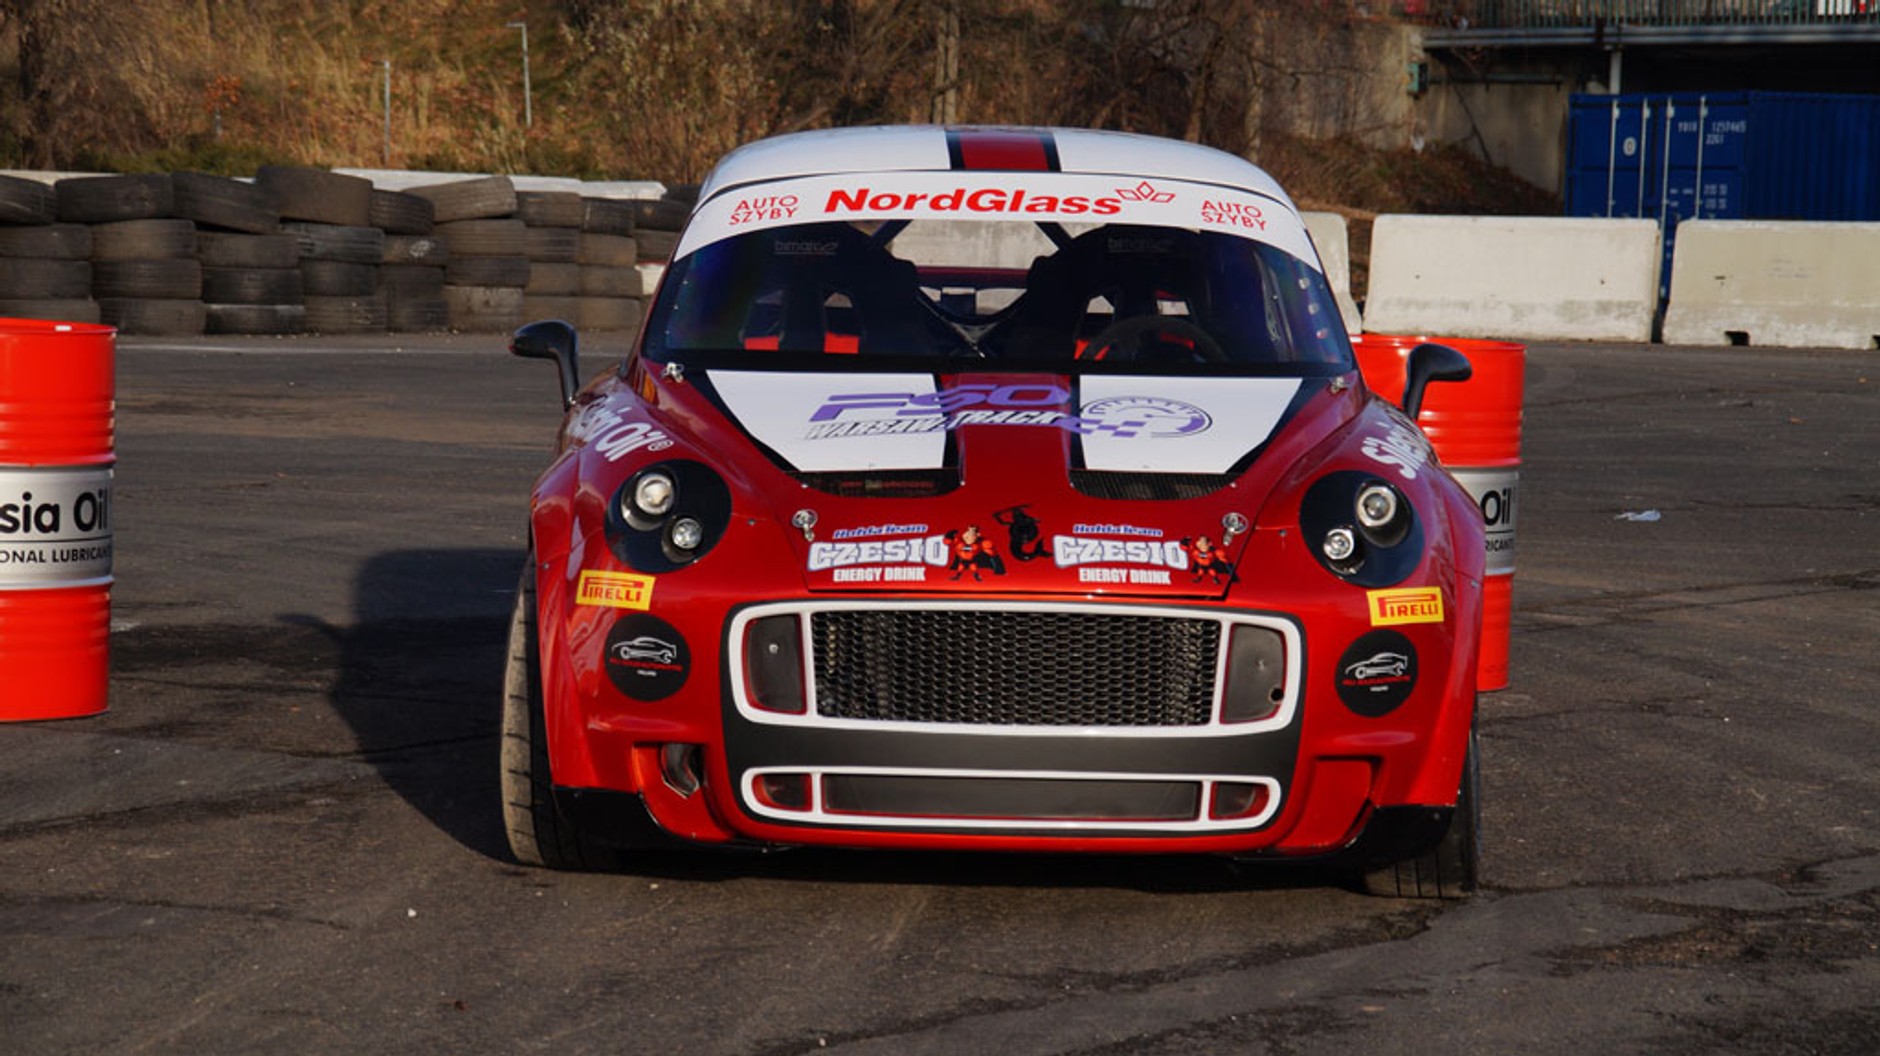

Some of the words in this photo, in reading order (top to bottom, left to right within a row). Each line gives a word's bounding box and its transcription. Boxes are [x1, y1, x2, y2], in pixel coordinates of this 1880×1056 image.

[735, 193, 799, 213] AUTO
[823, 187, 1124, 215] NordGlass
[1201, 199, 1264, 219] AUTO
[729, 206, 800, 226] SZYBY
[1200, 210, 1267, 232] SZYBY
[808, 384, 1071, 422] FSO
[804, 416, 948, 440] WARSAW
[947, 410, 1068, 431] TRACK
[807, 535, 949, 571] CZESIO
[1053, 535, 1188, 571] CZESIO
[832, 566, 882, 582] ENERGY
[884, 566, 927, 582] DRINK
[1078, 567, 1128, 583] ENERGY
[1130, 568, 1172, 584] DRINK
[582, 576, 644, 603] PIRELLI
[1377, 593, 1439, 618] PIRELLI
